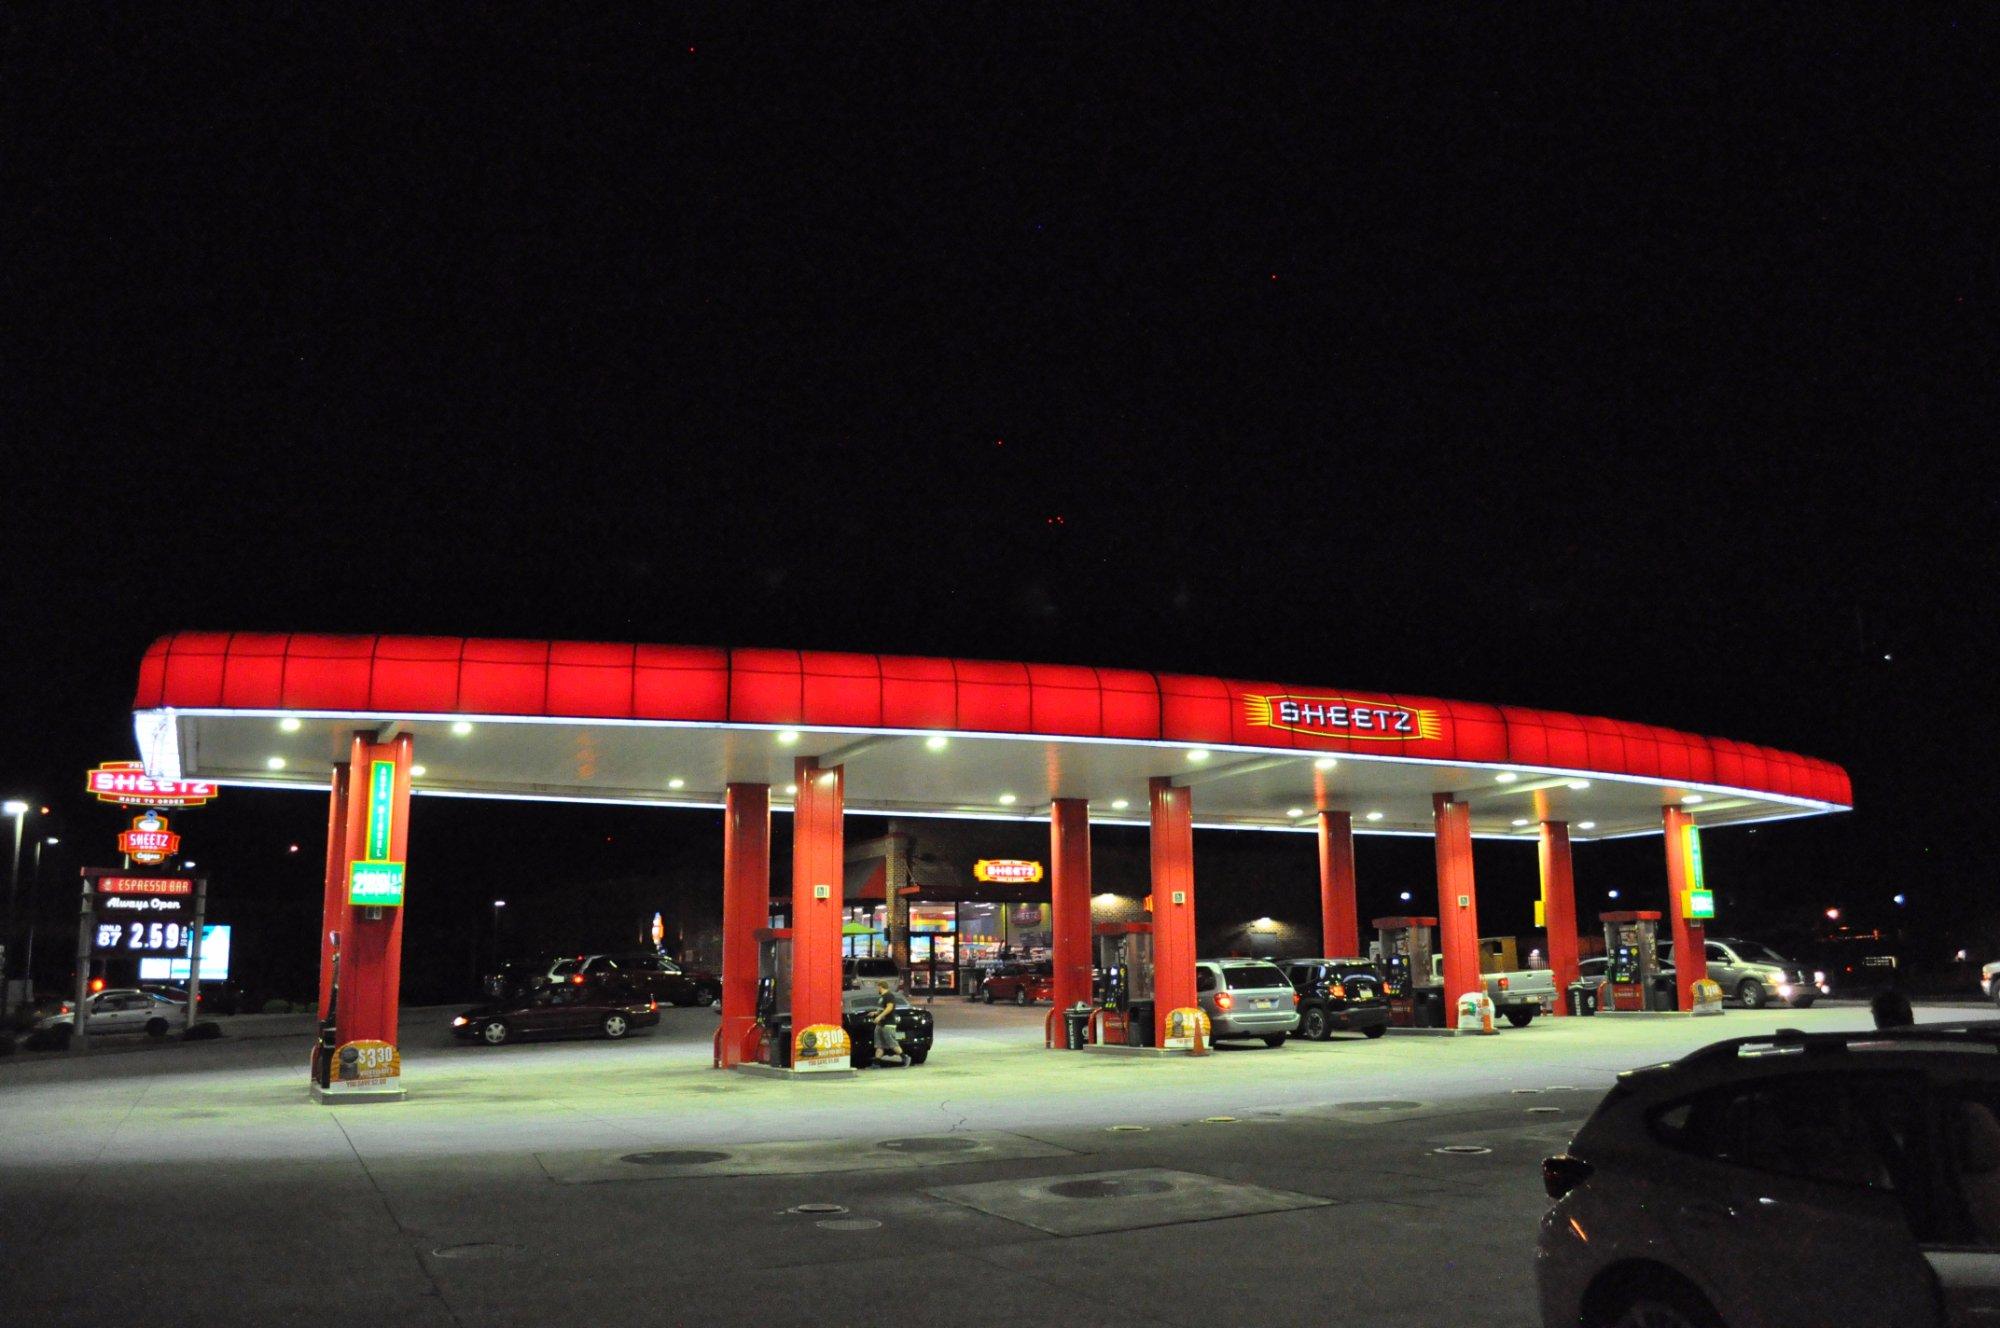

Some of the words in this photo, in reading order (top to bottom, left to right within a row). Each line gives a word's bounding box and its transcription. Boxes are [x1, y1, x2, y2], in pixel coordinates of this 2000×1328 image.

[1280, 701, 1413, 732] SHEETZ
[95, 773, 209, 793] SHEETZ
[130, 833, 169, 847] SHEETZ
[118, 879, 167, 892] ESPRESSO
[169, 881, 189, 892] BAR
[106, 897, 149, 911] Always
[150, 898, 181, 910] Open
[97, 931, 122, 946] 87
[129, 922, 180, 949] 2.59
